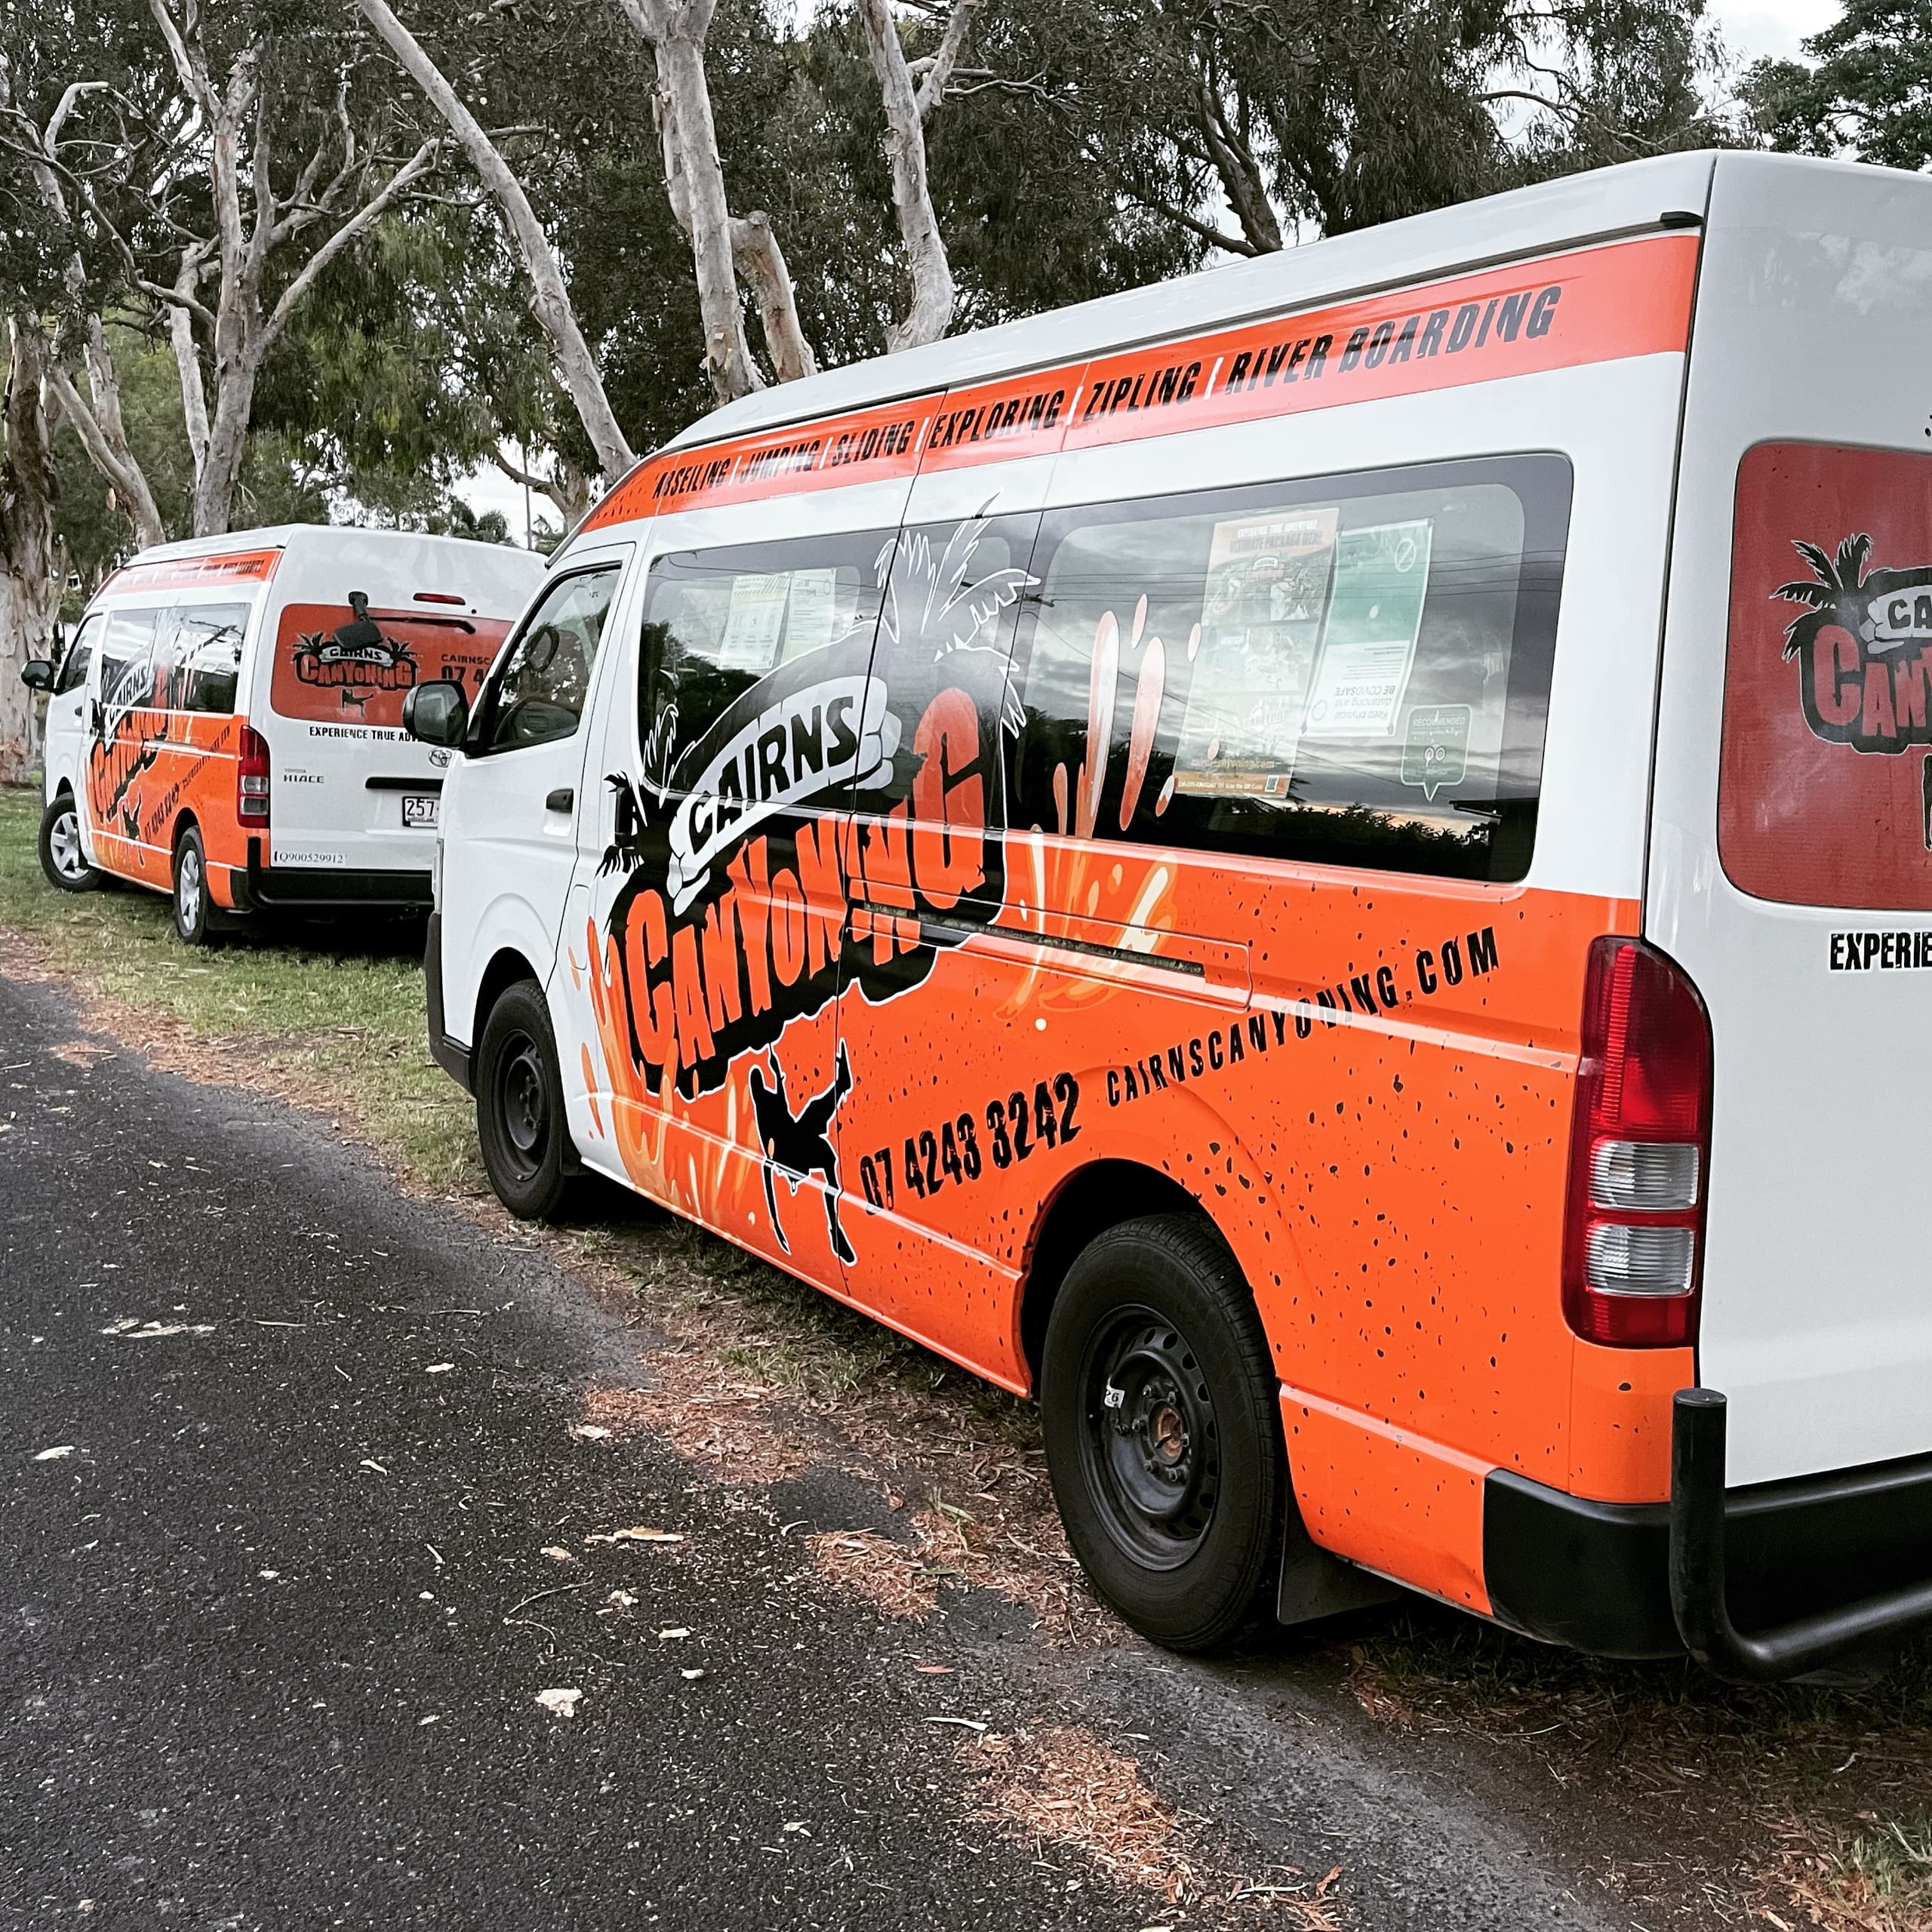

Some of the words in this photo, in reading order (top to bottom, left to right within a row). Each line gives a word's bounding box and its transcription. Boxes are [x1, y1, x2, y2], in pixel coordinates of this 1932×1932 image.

[740, 440, 822, 484] JUMPING
[832, 420, 915, 466] SLIDING
[928, 390, 1065, 450] EXPLORING
[1084, 361, 1201, 421] ZIPLING
[1225, 334, 1333, 395] RIVER
[1337, 285, 1562, 374] BOARDING
[441, 654, 495, 664] CAIRNSC
[302, 654, 411, 688] CANYONING
[1383, 685, 1395, 695] BE
[309, 727, 368, 740] EXPERIENCE
[372, 730, 395, 740] TRUE
[284, 774, 325, 783] HIACE
[688, 695, 857, 856] CAIRNS
[279, 851, 343, 863] Q900529912
[626, 687, 985, 1070] CANYONING
[860, 1147, 894, 1216] 07
[905, 1112, 982, 1199] 4243
[986, 1072, 1082, 1169] 3242
[1106, 925, 1499, 1108] CAIRNSCANYONING.COM
